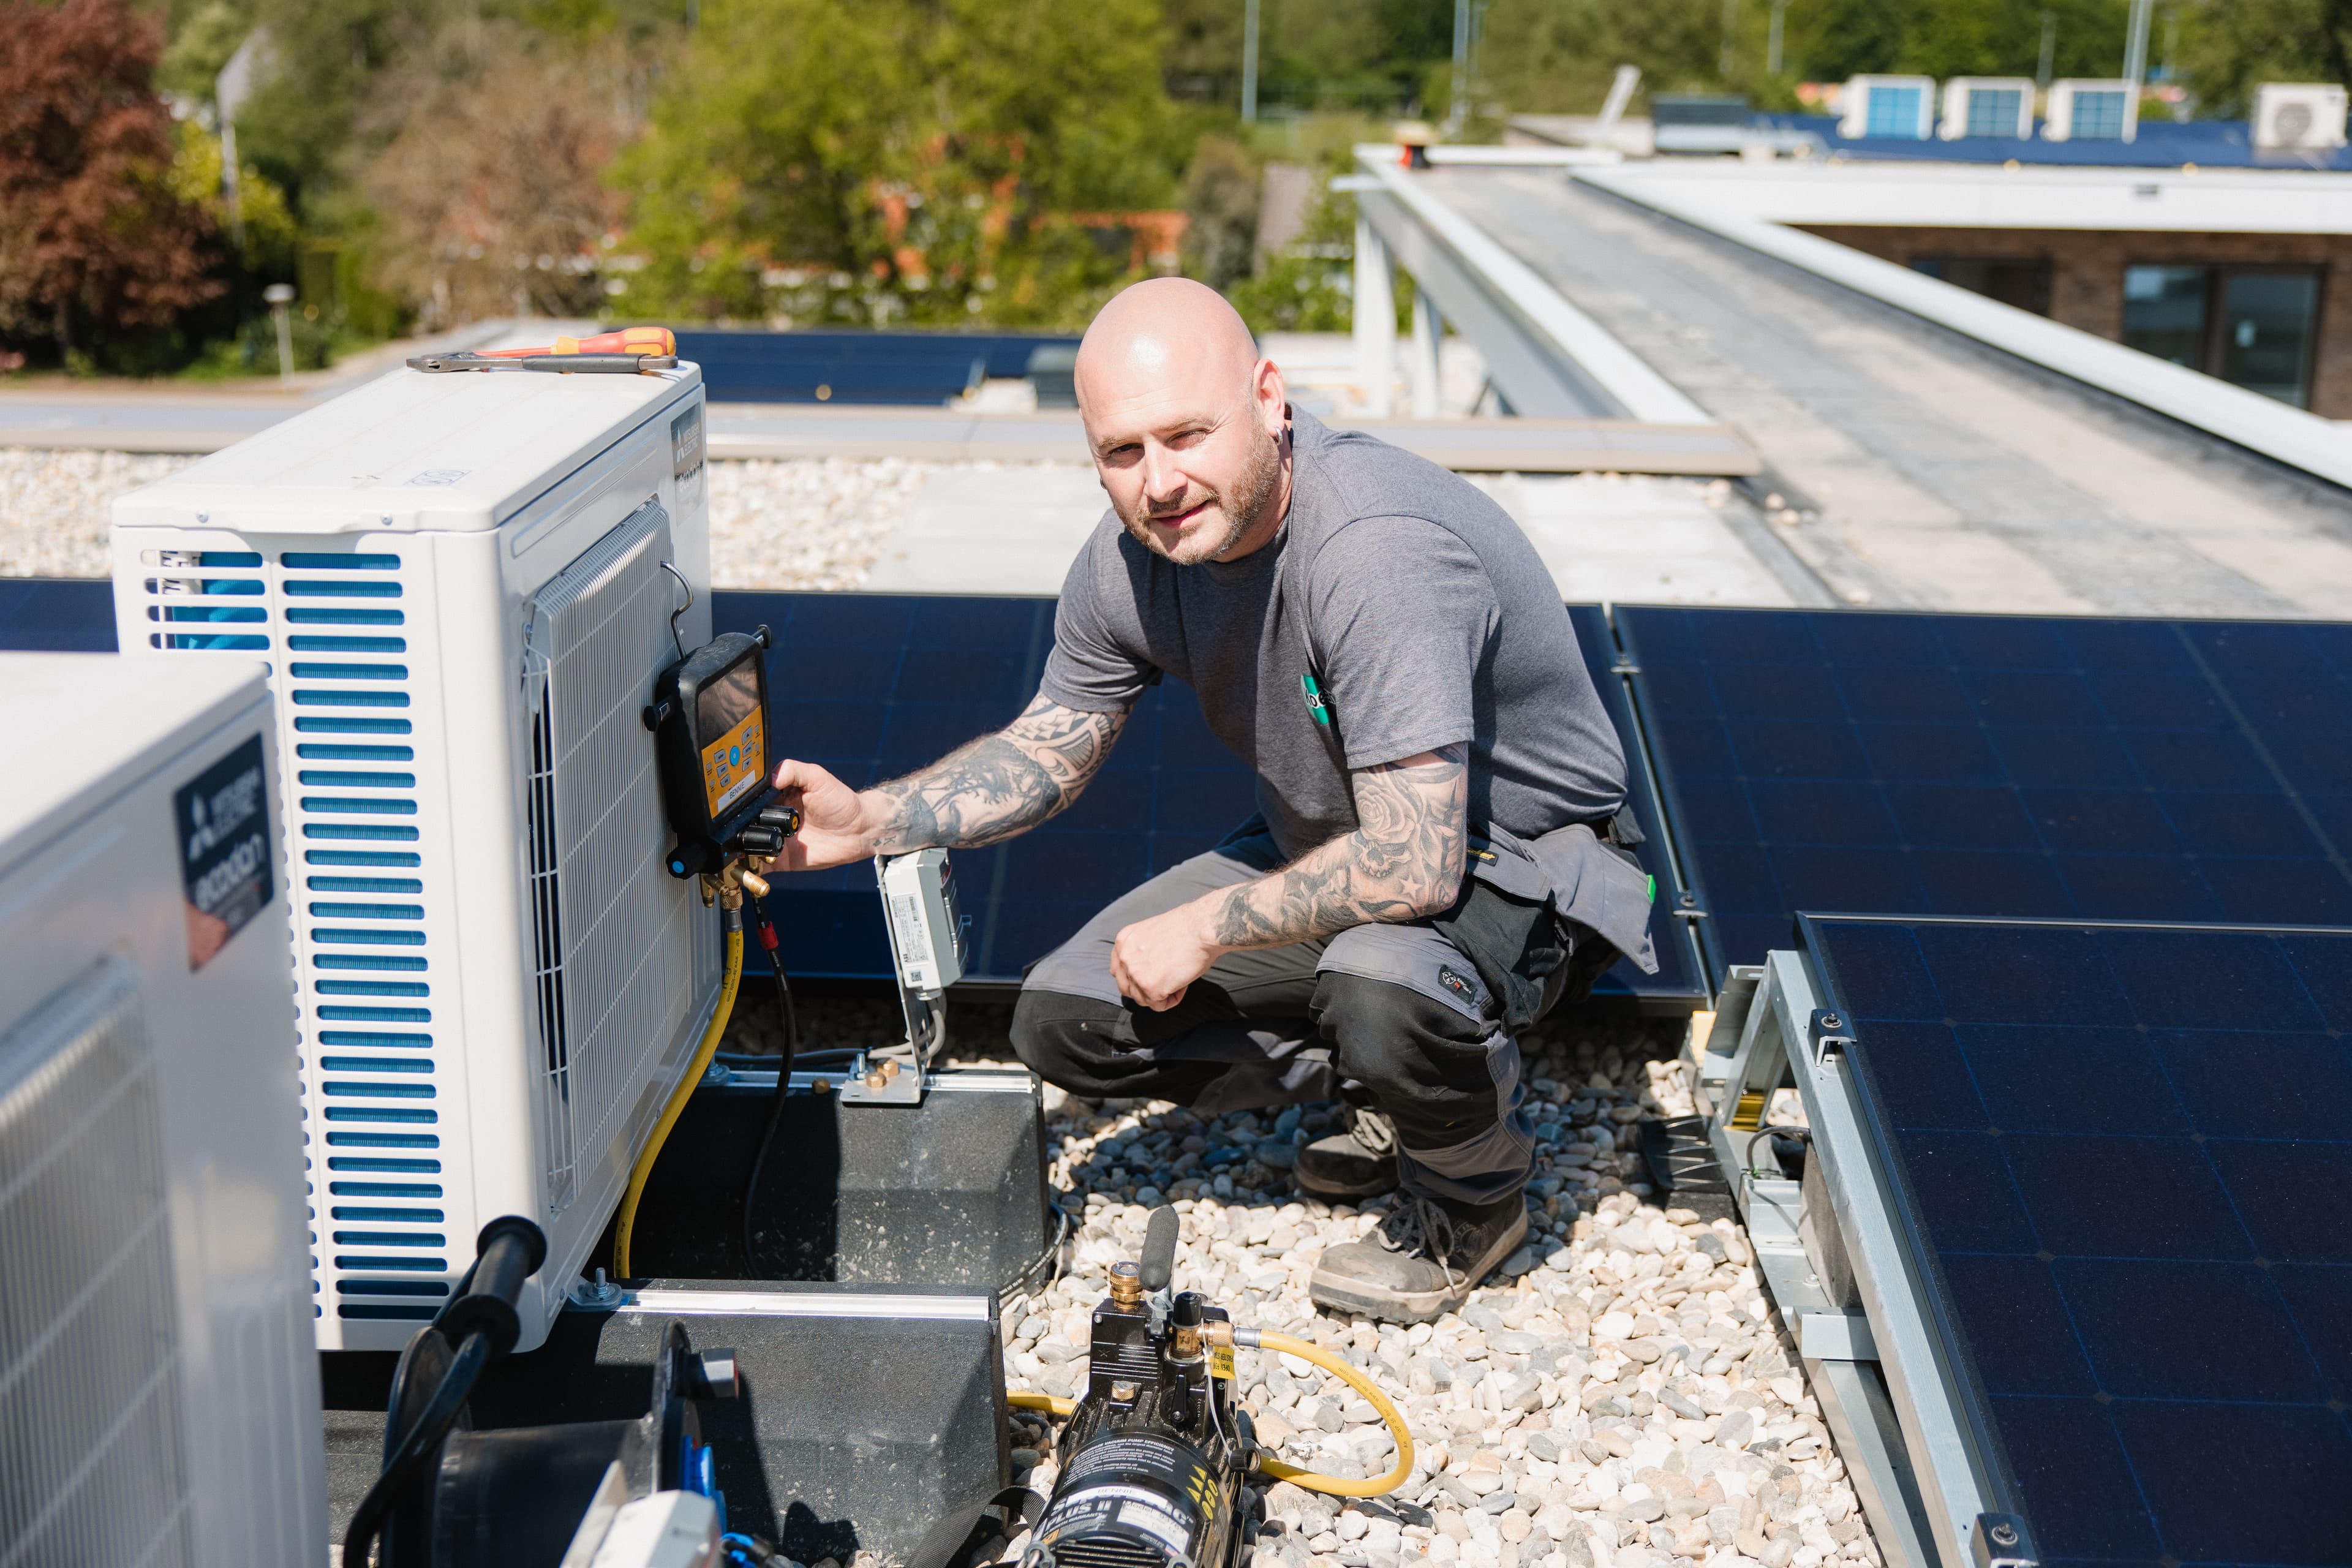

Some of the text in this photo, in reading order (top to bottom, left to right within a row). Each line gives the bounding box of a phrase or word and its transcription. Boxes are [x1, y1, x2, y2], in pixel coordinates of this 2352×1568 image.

[729, 781, 745, 799] BENNIE
[1221, 1352, 1234, 1362] FASTER
[1220, 1363, 1231, 1372] OPEN
[1144, 1439, 1175, 1452] EFFICIENCY
[1045, 1502, 1093, 1532] PLUS
